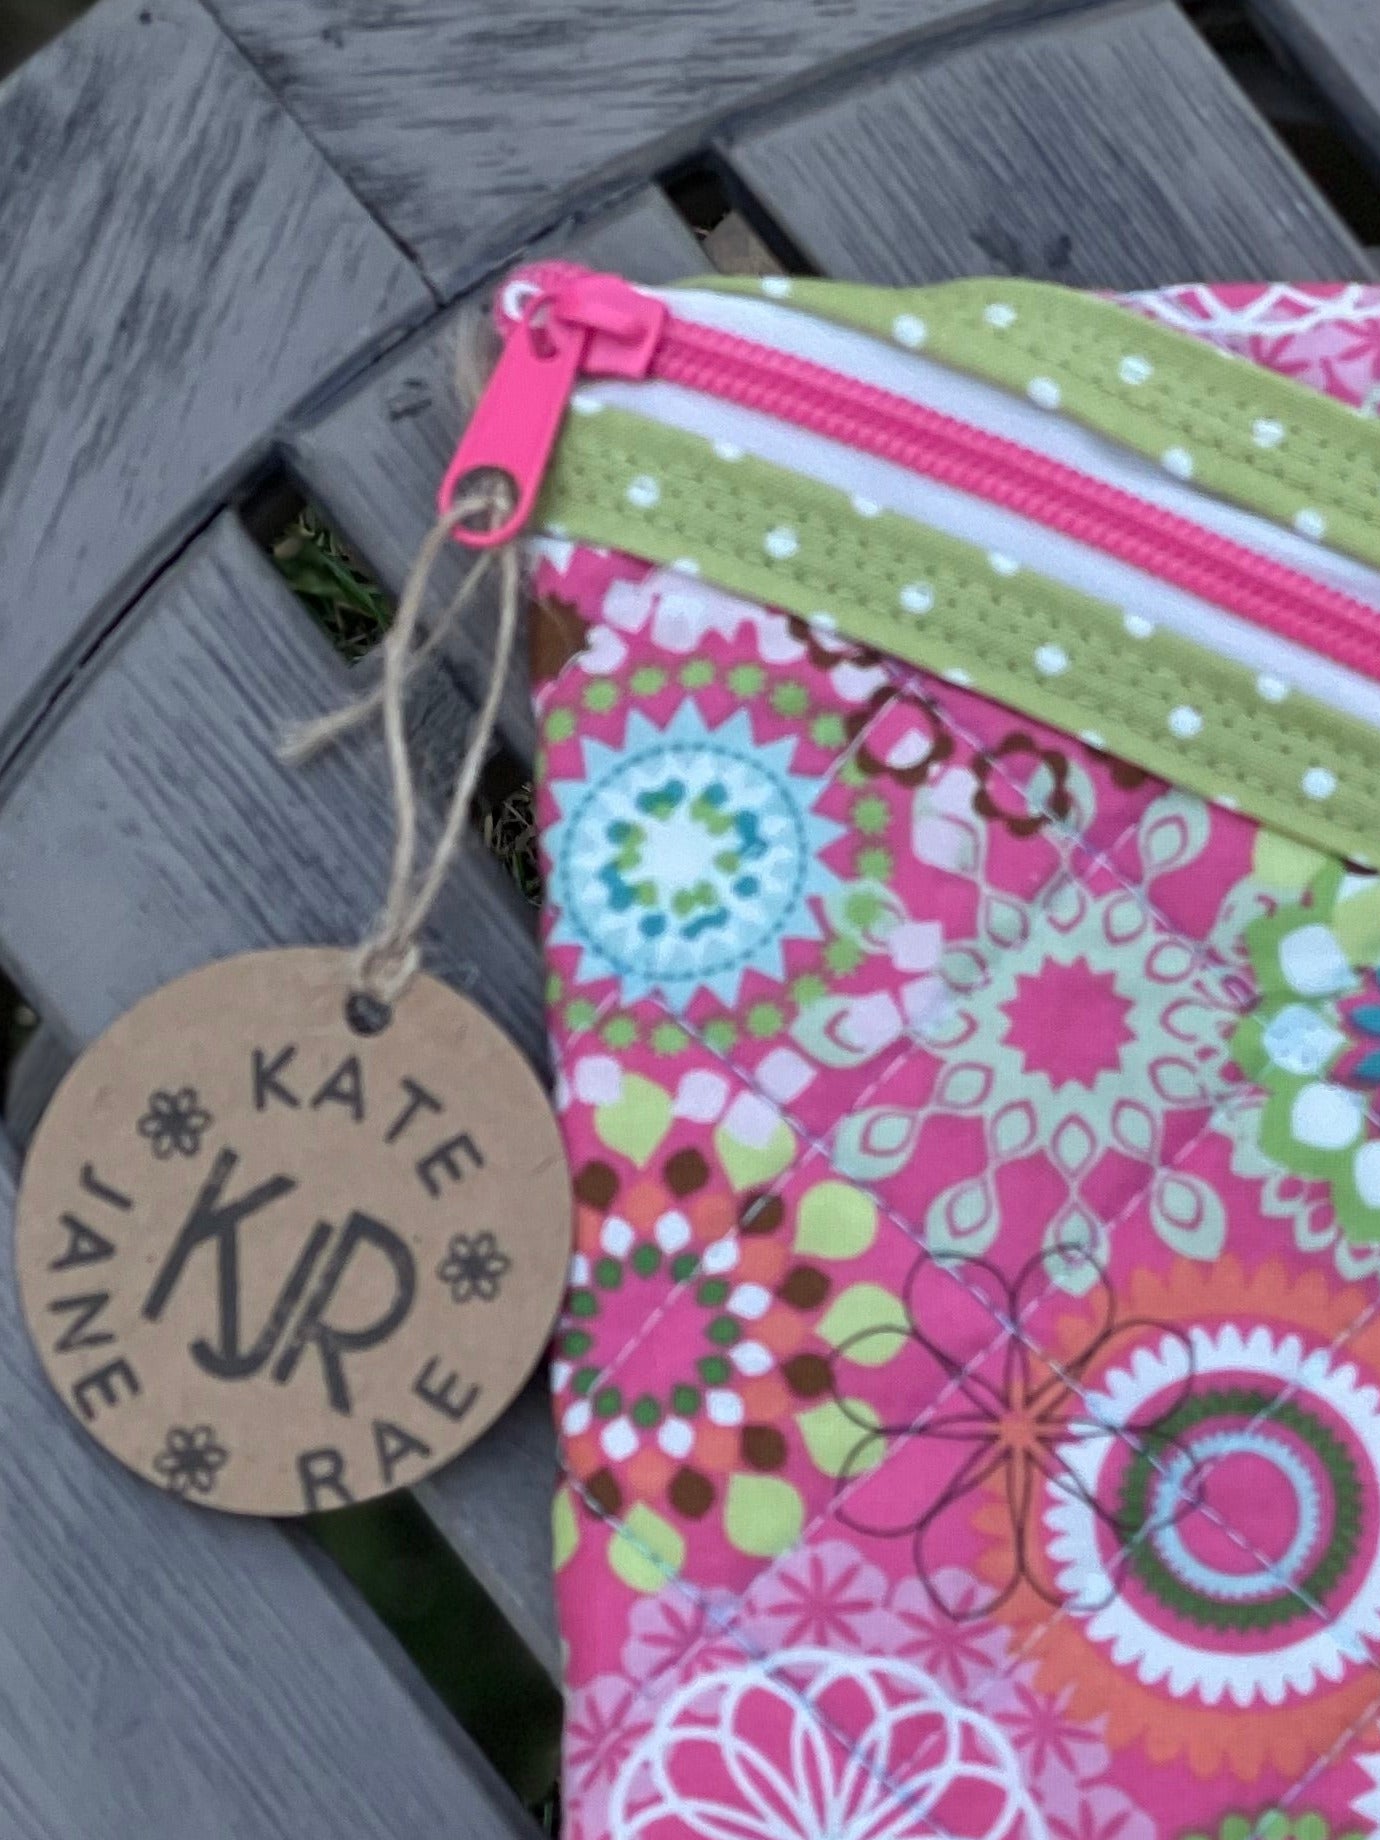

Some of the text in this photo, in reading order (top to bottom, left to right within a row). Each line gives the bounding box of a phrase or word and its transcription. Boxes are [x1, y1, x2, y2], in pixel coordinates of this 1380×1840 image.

[252, 1045, 485, 1200] KATE
[47, 1163, 141, 1419] JANE
[297, 1356, 481, 1510] RAE
